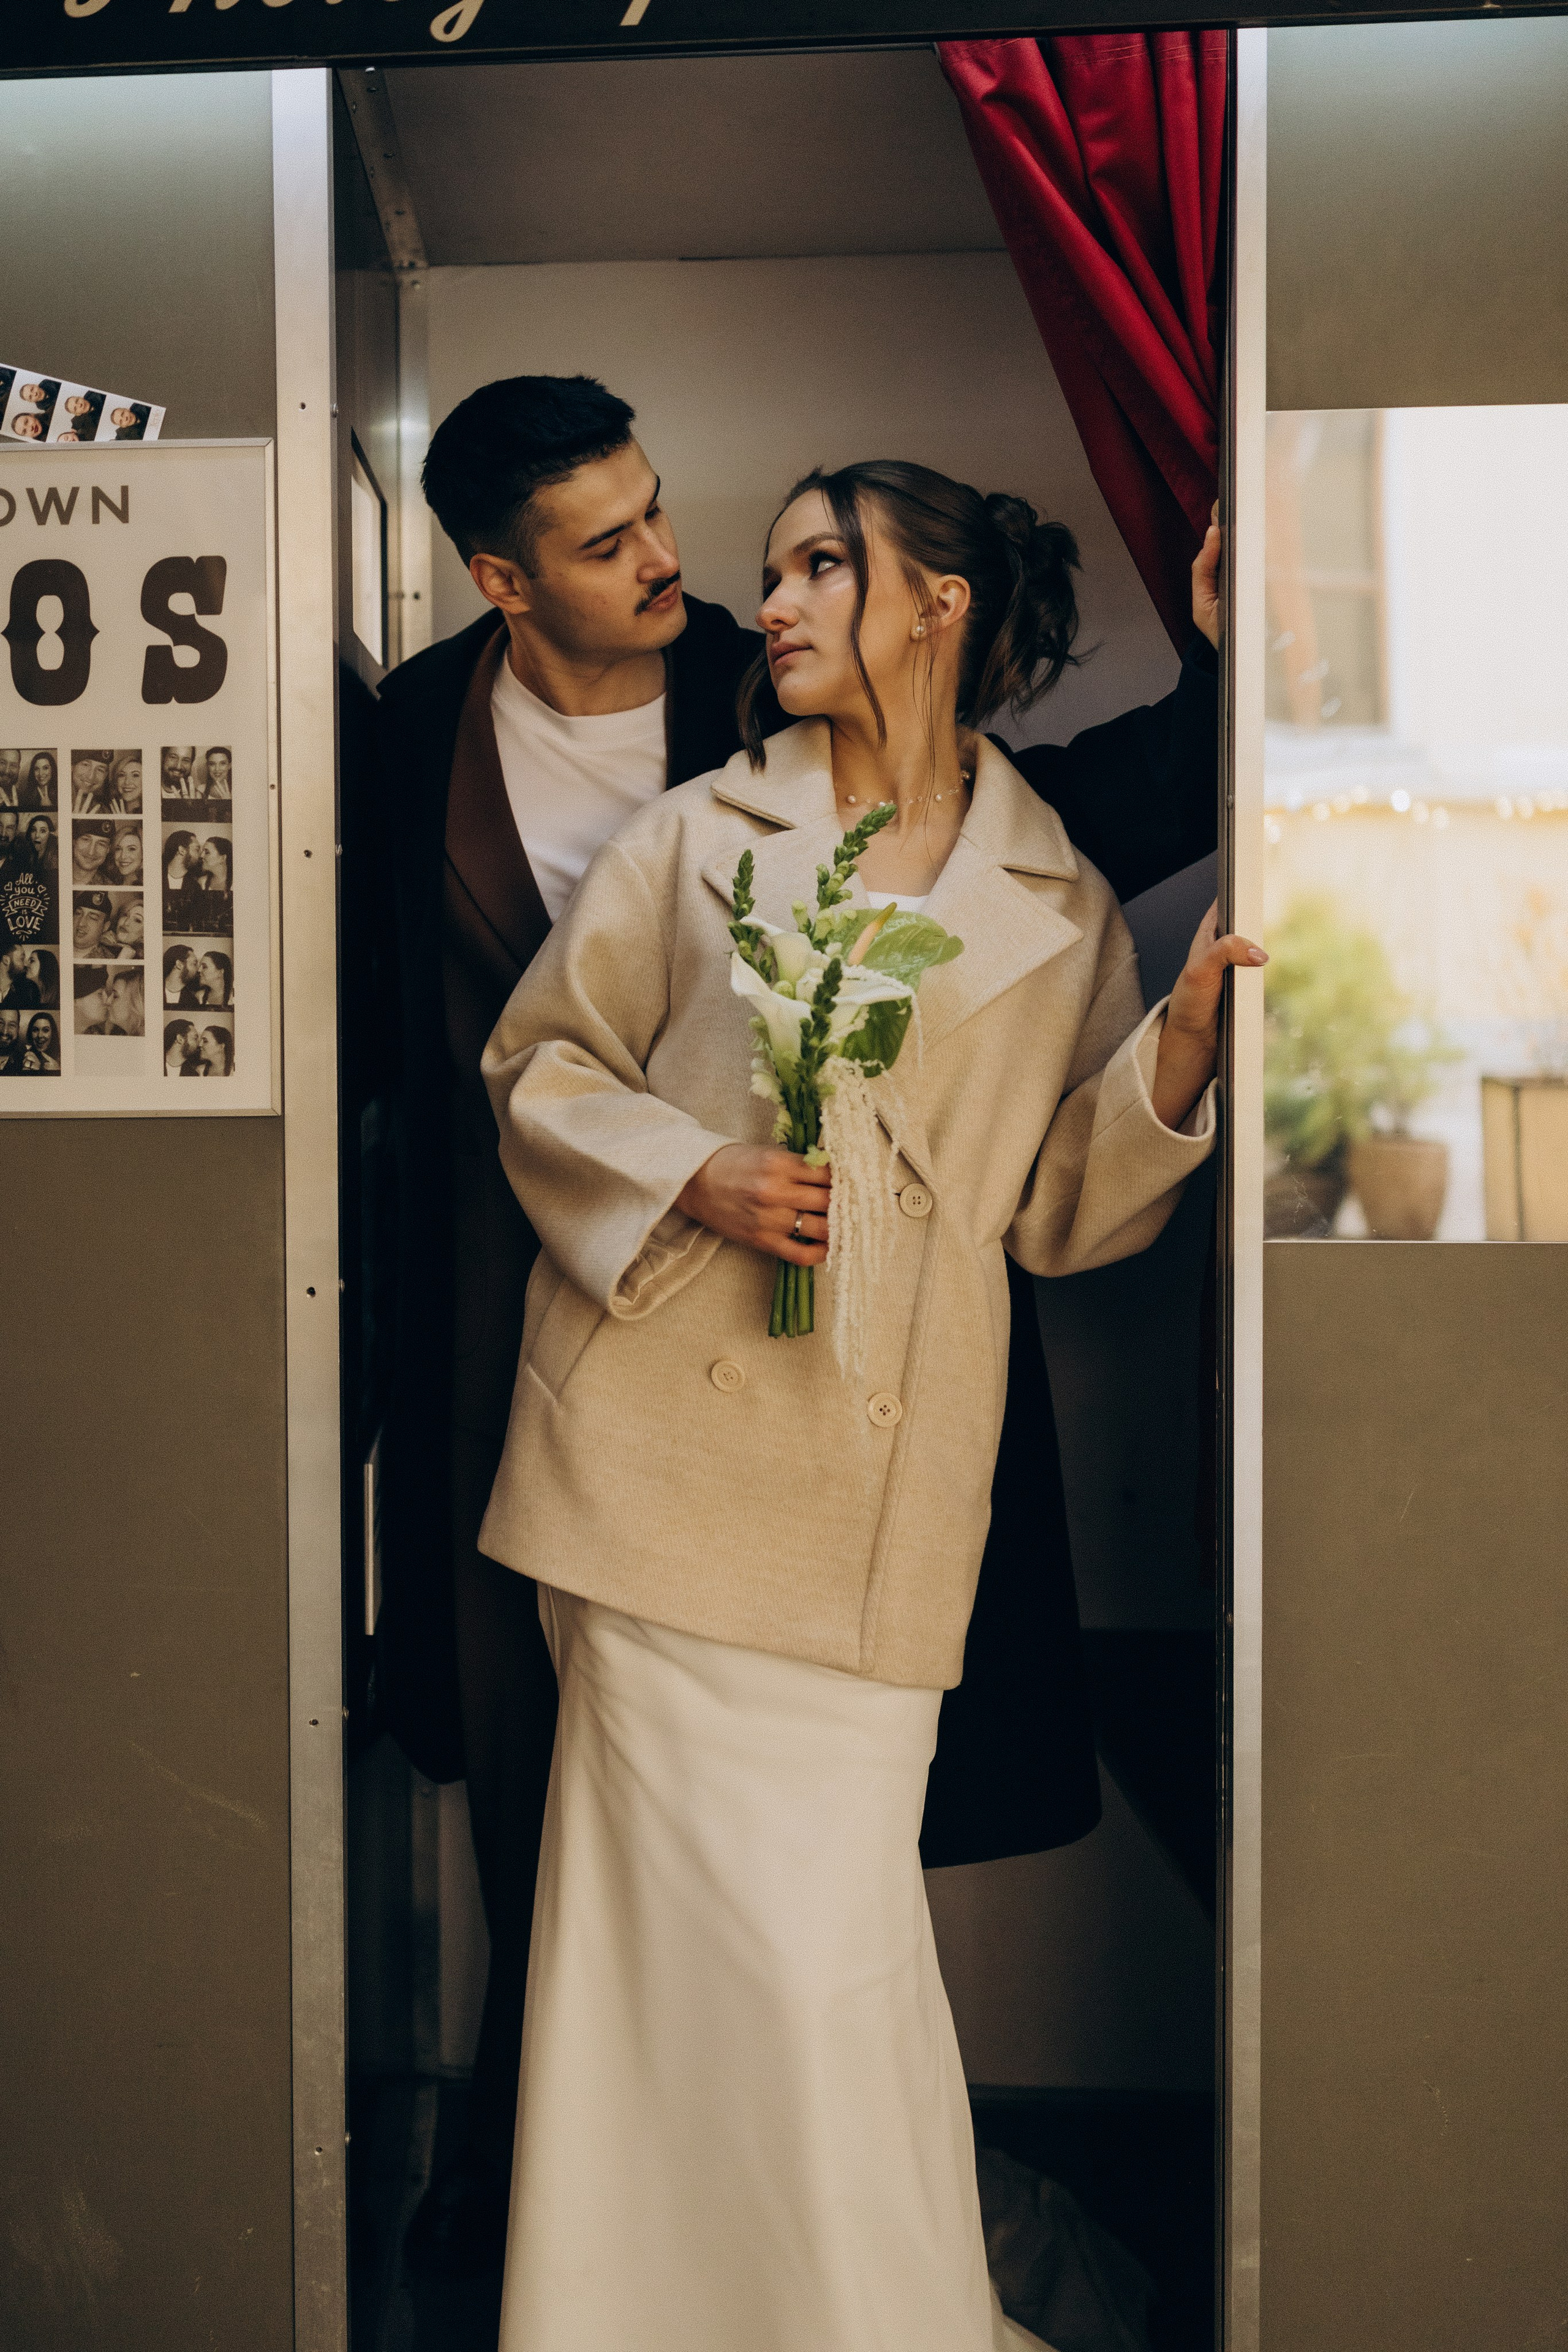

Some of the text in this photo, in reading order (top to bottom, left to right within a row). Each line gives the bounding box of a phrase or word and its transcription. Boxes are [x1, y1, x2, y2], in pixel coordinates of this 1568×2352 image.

[15, 873, 34, 886] All
[10, 887, 35, 899] you
[7, 916, 43, 931] LOVE
